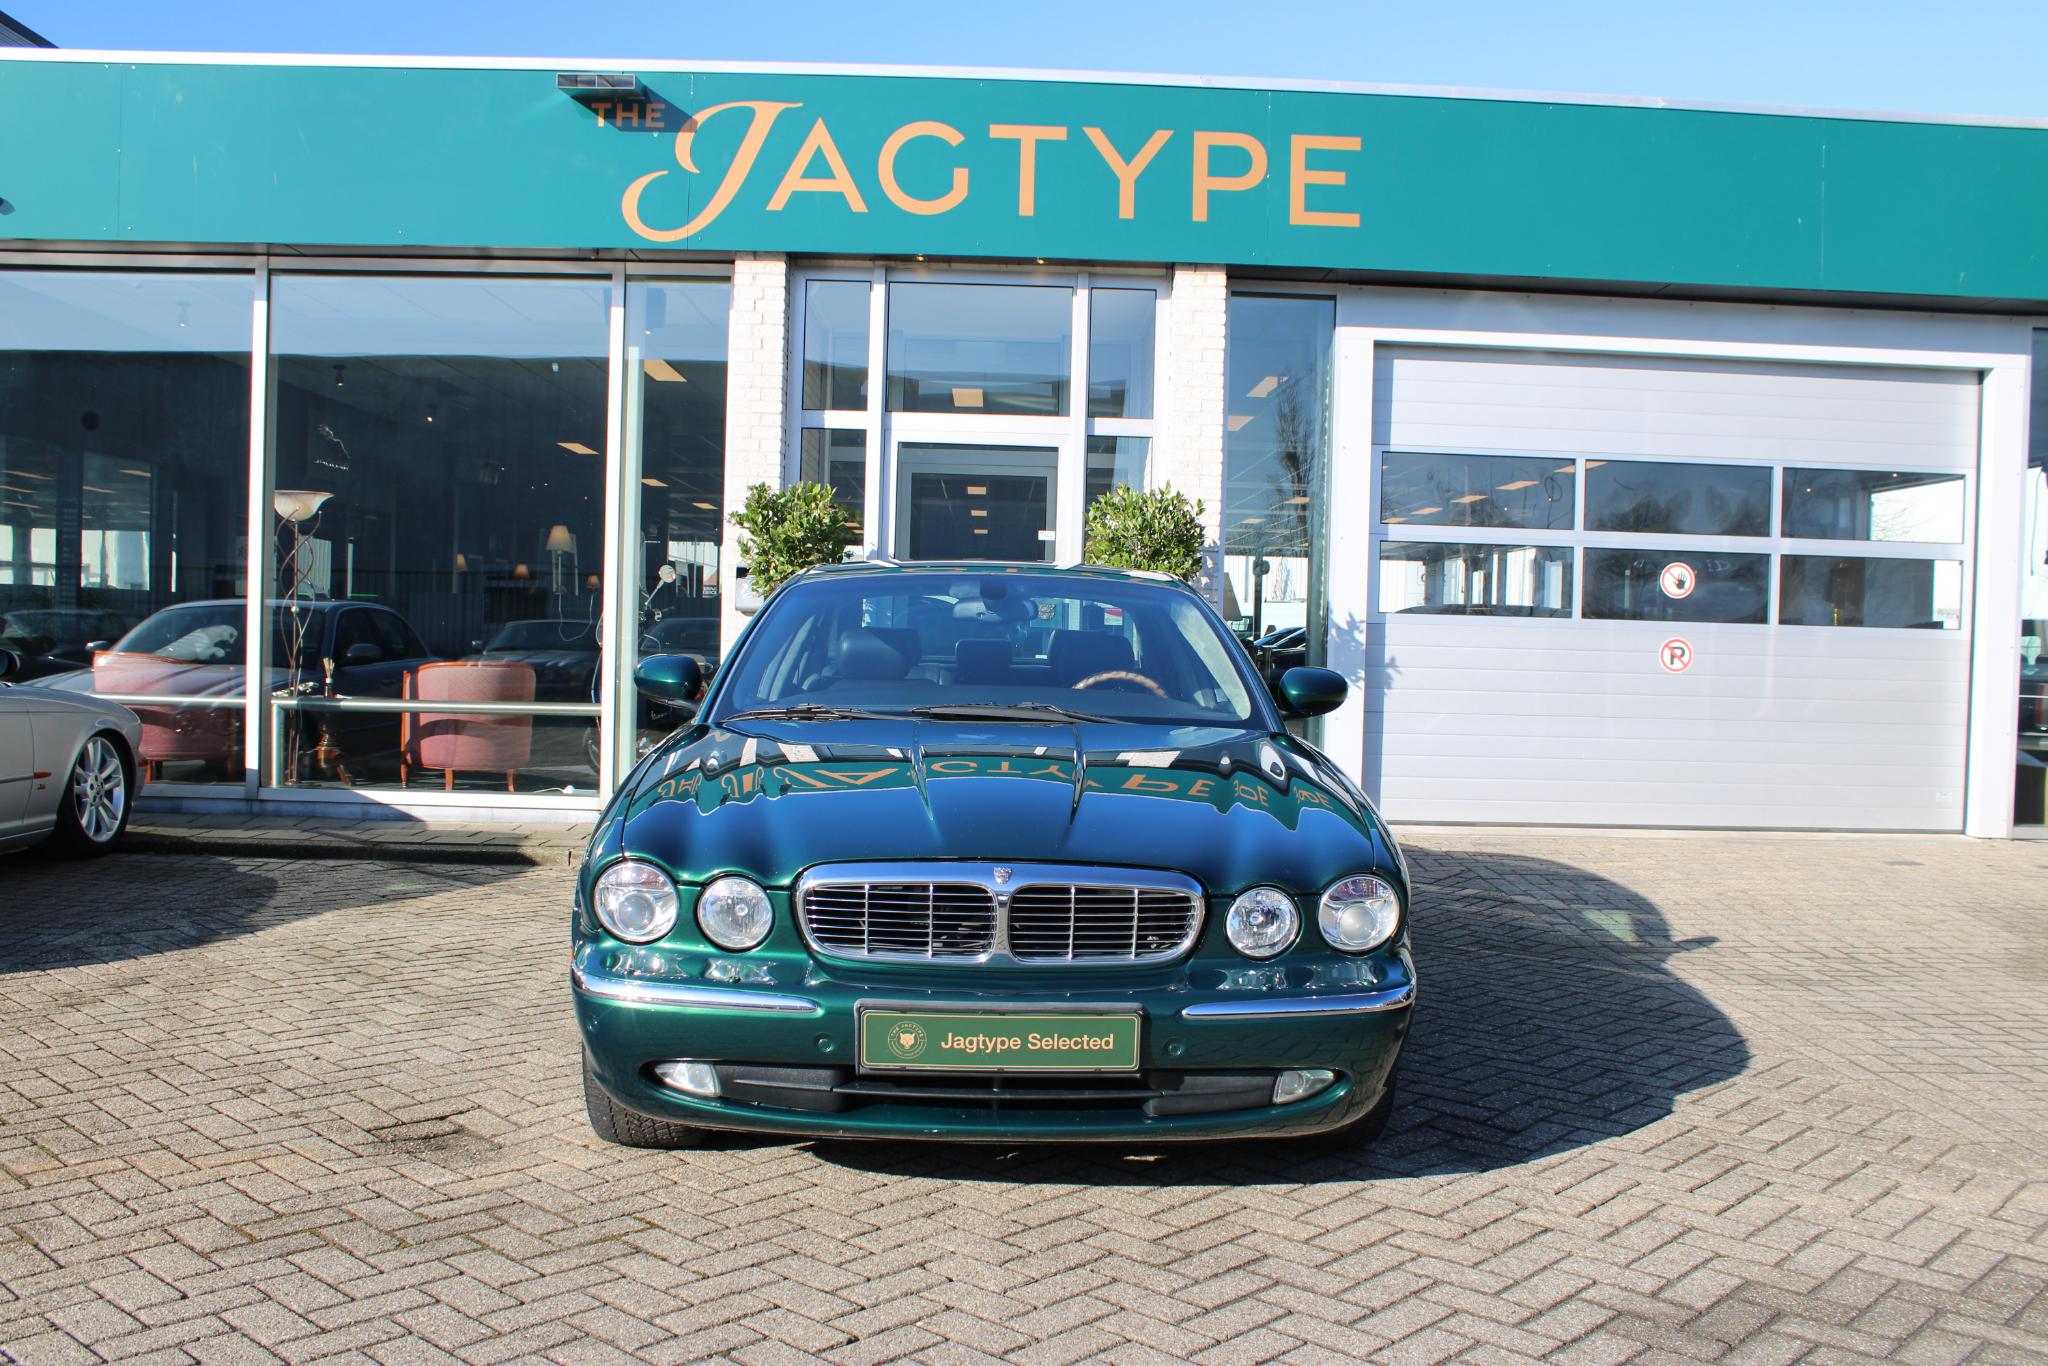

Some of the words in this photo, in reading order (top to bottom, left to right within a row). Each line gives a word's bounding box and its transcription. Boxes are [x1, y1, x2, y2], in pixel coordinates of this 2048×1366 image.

[591, 102, 666, 128] THE
[621, 100, 1362, 242] JAGTYPE
[940, 1032, 1022, 1054] Jagtype
[1026, 1033, 1115, 1051] Selected
